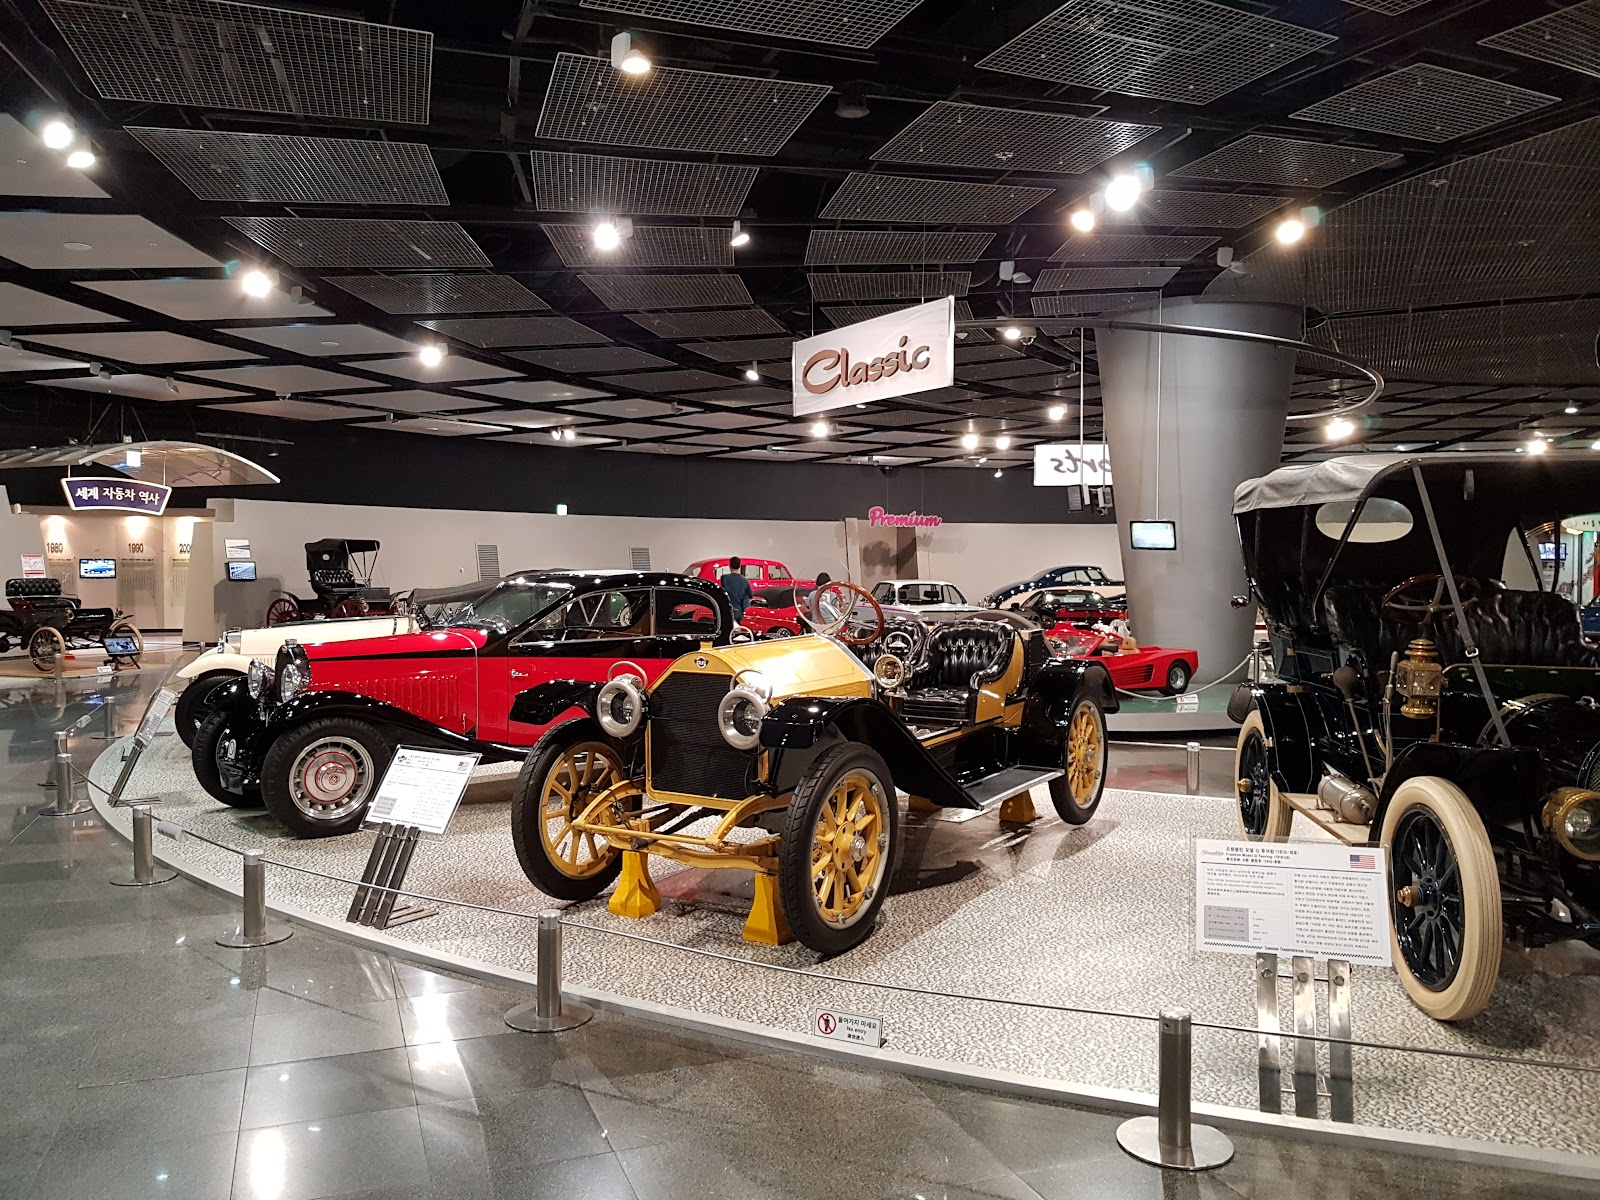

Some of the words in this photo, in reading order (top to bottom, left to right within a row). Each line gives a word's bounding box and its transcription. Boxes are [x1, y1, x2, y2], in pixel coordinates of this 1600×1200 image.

[802, 335, 931, 394] Classic
[75, 486, 99, 500] 세계
[103, 487, 136, 501] 자동차
[138, 491, 160, 505] 역사
[868, 506, 942, 527] Premium
[128, 543, 144, 554] 1990
